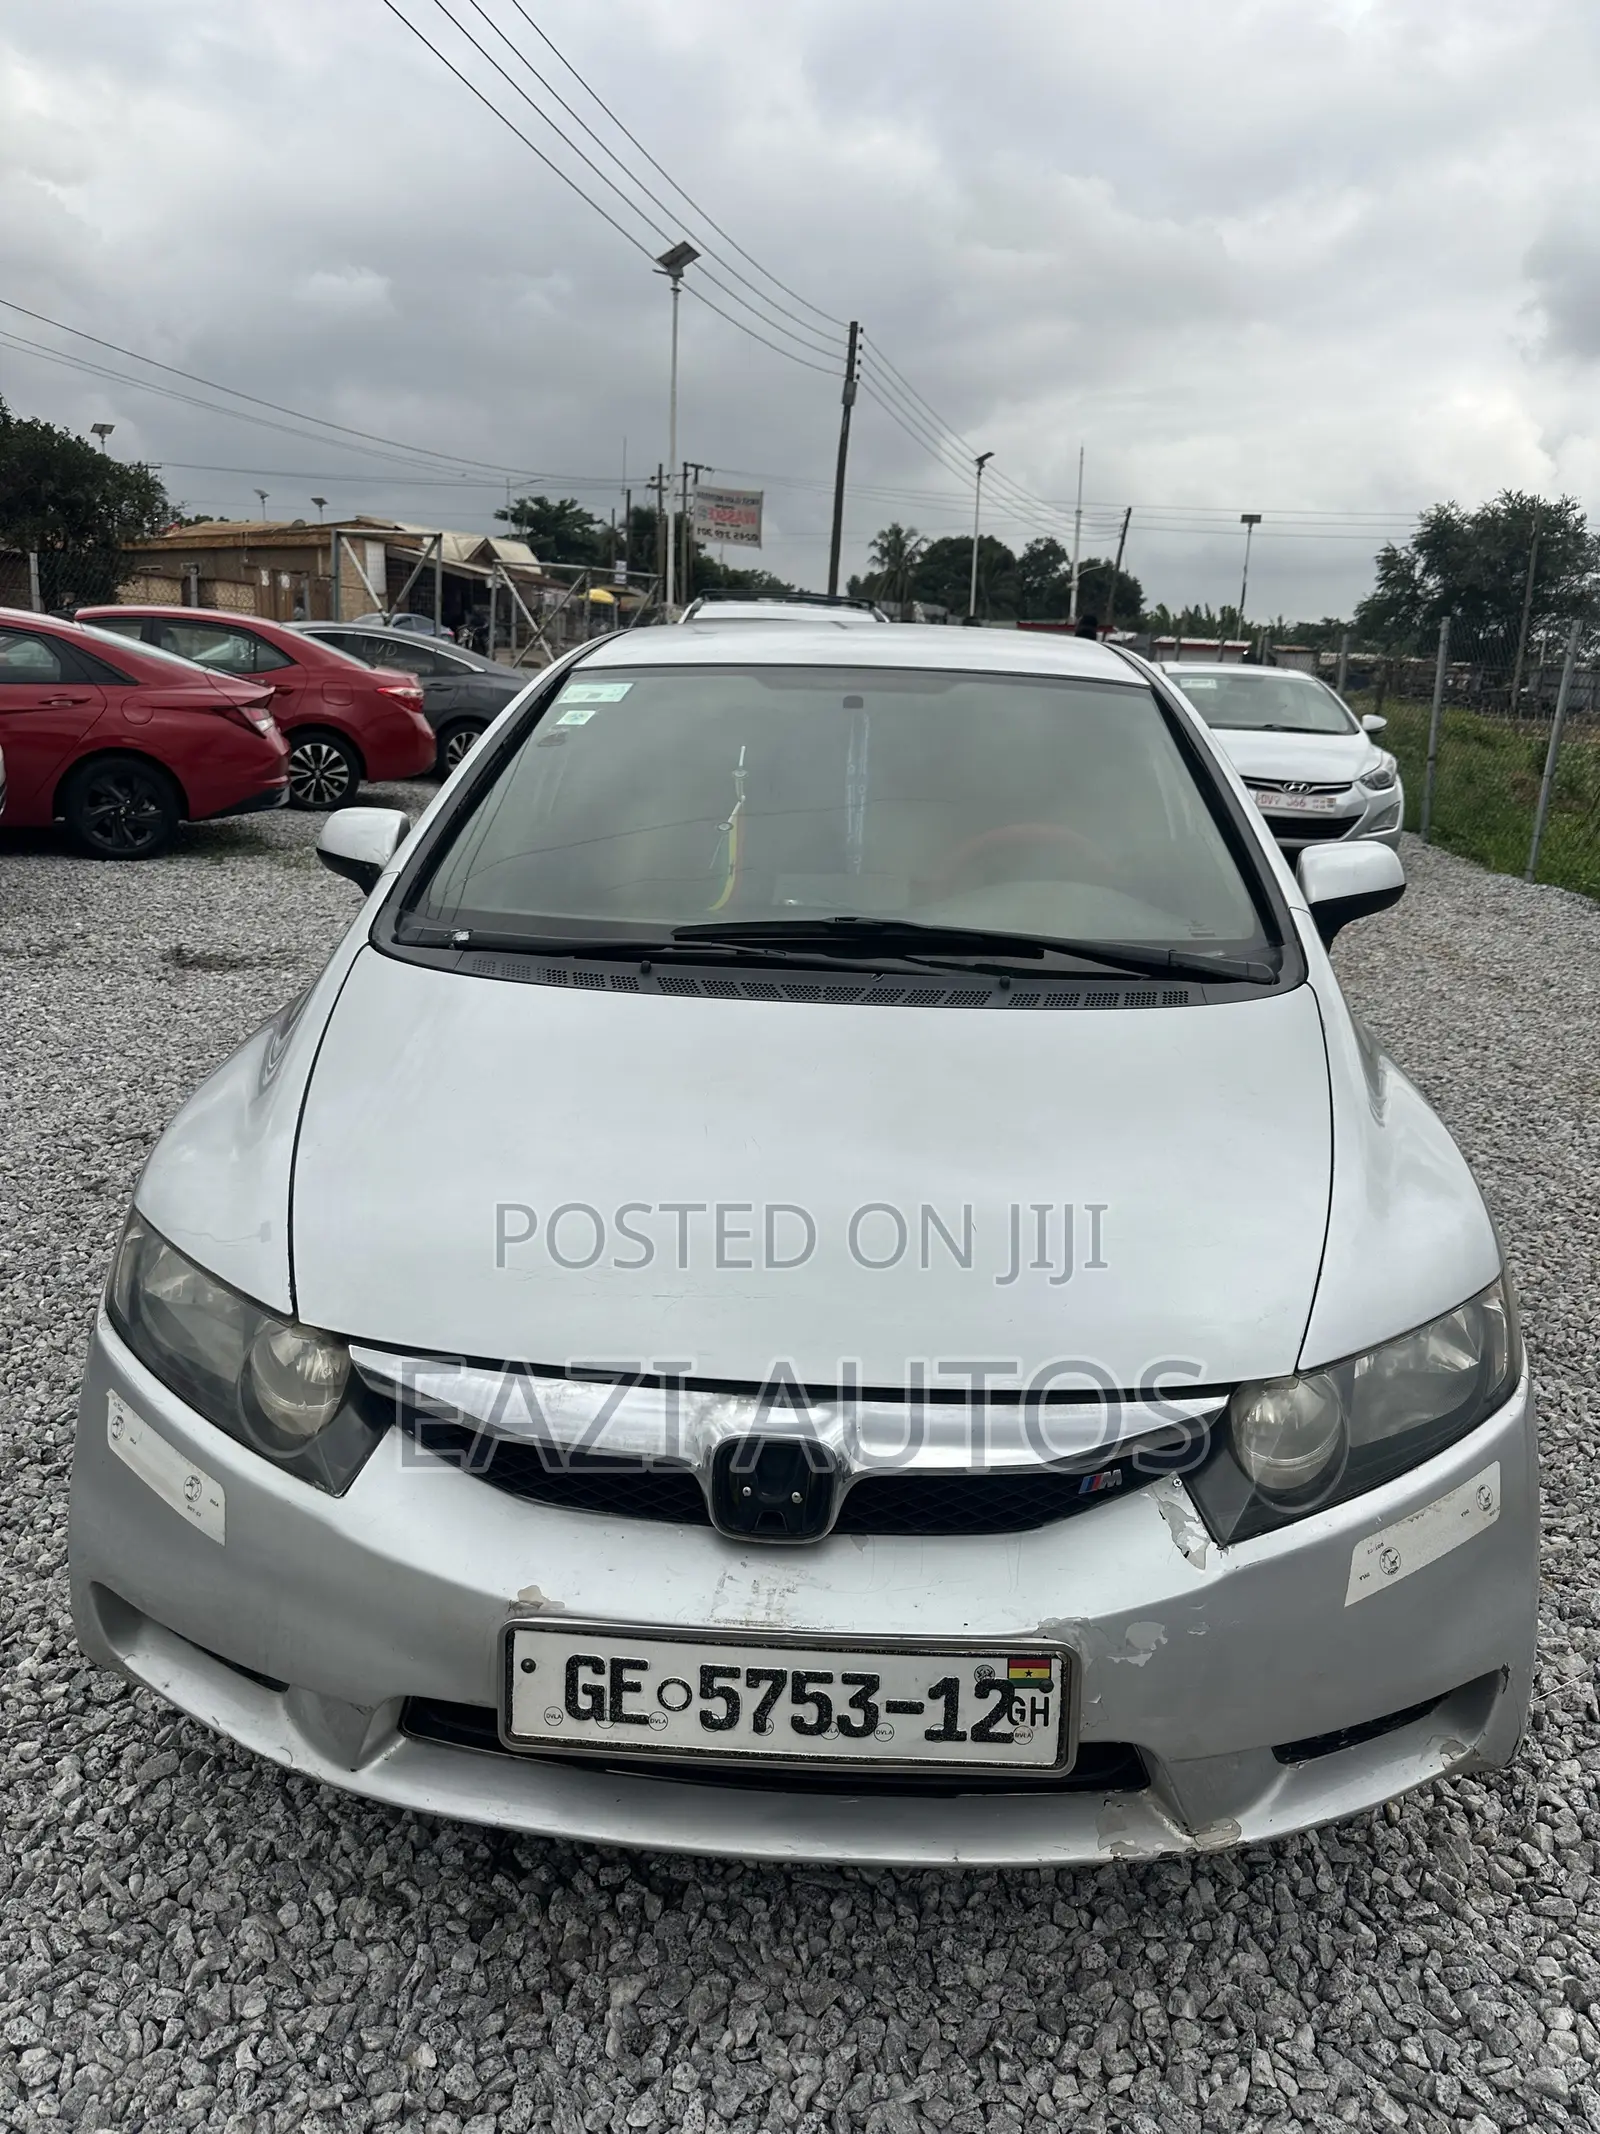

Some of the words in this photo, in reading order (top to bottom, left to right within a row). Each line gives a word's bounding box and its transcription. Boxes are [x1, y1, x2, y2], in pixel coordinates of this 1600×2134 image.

[565, 1654, 649, 1725] GE
[699, 1663, 1016, 1743] 5753-12
[1007, 1695, 1049, 1726] GH
